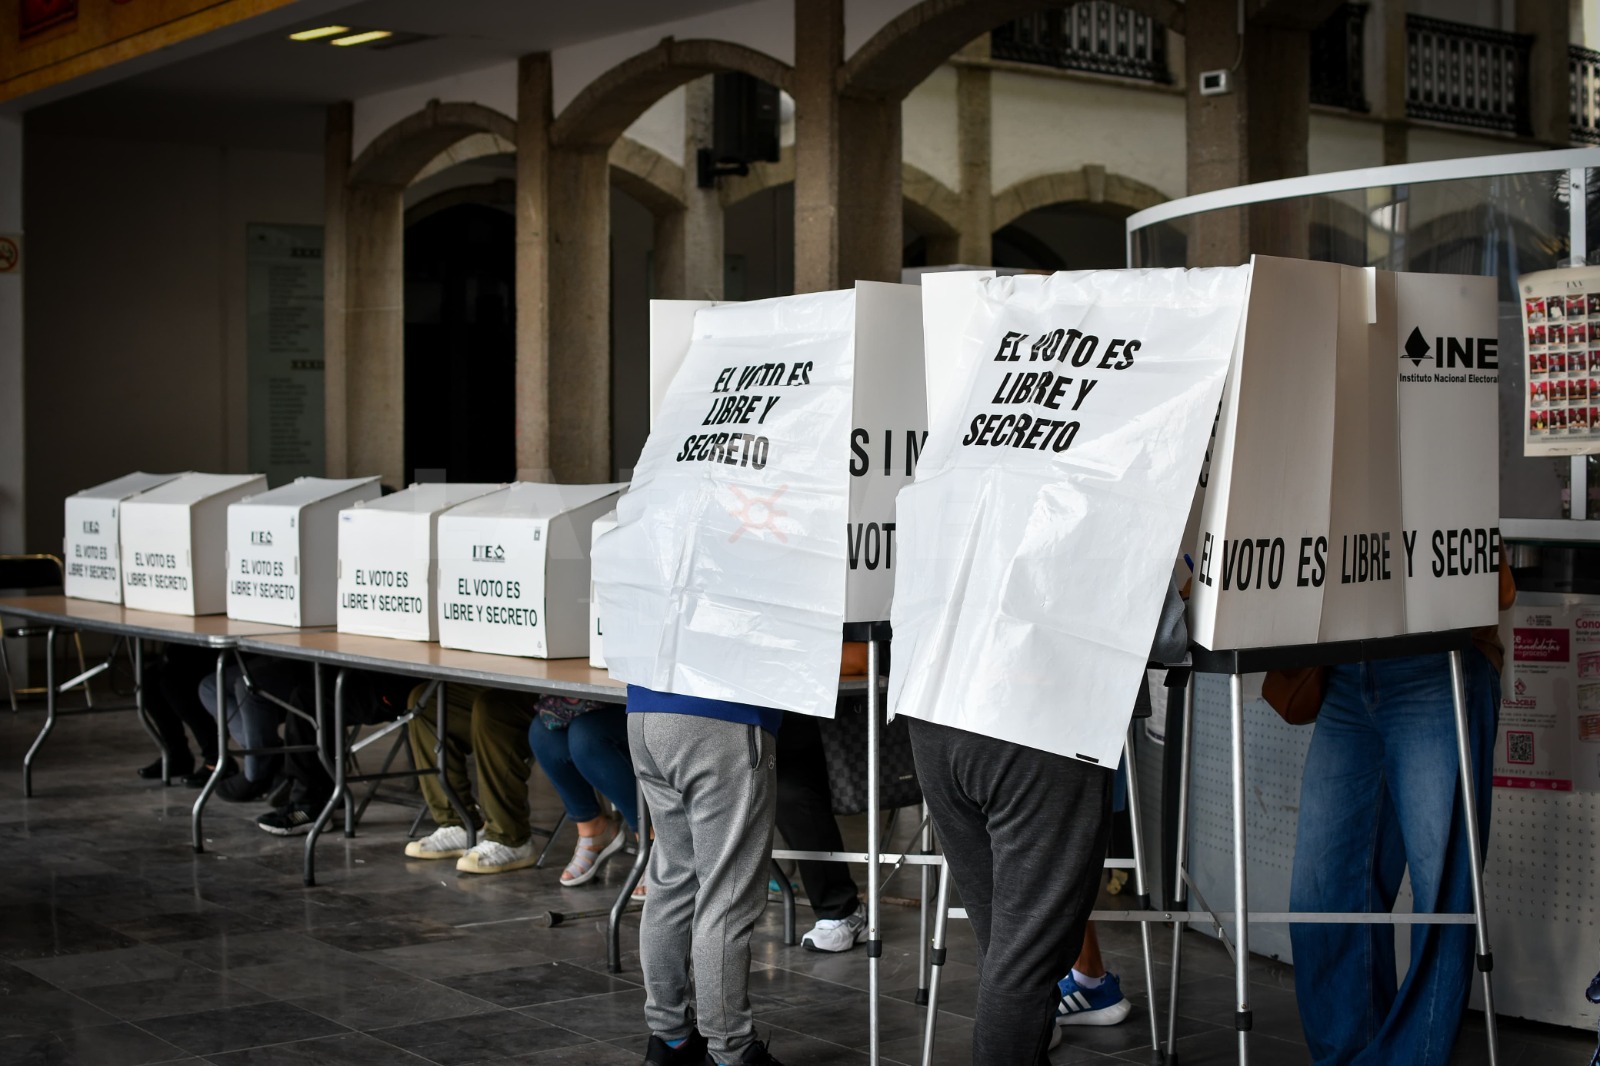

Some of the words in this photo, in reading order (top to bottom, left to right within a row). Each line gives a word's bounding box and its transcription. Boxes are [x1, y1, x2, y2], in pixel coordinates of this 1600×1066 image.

[994, 331, 1030, 361] EL
[1028, 328, 1100, 368] VOTO
[1096, 338, 1141, 370] ES
[1436, 335, 1499, 371] INE
[713, 367, 739, 393] EL
[785, 361, 813, 386] ES
[1400, 373, 1432, 382] Instituto
[1434, 374, 1466, 382] Nacional
[1469, 373, 1499, 385] Electoral
[992, 371, 1074, 410] LIBRE
[1070, 378, 1098, 410] Y
[702, 395, 764, 425] LIBRE
[757, 396, 780, 424] Y
[963, 413, 1080, 453] SECRETO
[676, 432, 769, 470] SECRETO
[84, 546, 98, 559] VOTO
[100, 546, 107, 560] ES
[135, 552, 144, 566] EL
[145, 553, 165, 568] VOTO
[166, 555, 175, 569] ES
[1198, 530, 1215, 588] EL
[1223, 537, 1285, 591] VOTO
[1297, 536, 1328, 588] ES
[1341, 532, 1391, 584] LIBRE
[1402, 529, 1417, 578] Y
[89, 565, 116, 580] SECRETO
[242, 559, 249, 574] EL
[252, 560, 271, 576] VOTO
[274, 562, 283, 576] ES
[127, 573, 147, 587] LIBRE
[148, 575, 153, 586] Y
[155, 574, 187, 590] SECRETO
[356, 570, 366, 585] EL
[369, 571, 393, 587] VOTO
[397, 572, 408, 587] ES
[459, 578, 470, 595] EL
[474, 579, 502, 597] VOTO
[507, 581, 520, 599] ES
[232, 581, 251, 596] LIBRE
[253, 583, 258, 596] Y
[260, 583, 294, 600] SECRETO
[343, 593, 368, 609] LIBRE
[371, 595, 376, 610] Y
[379, 595, 422, 613] SECRETO
[444, 603, 473, 621] LIBRE
[476, 606, 483, 622] Y
[486, 606, 537, 626] SECRETO
